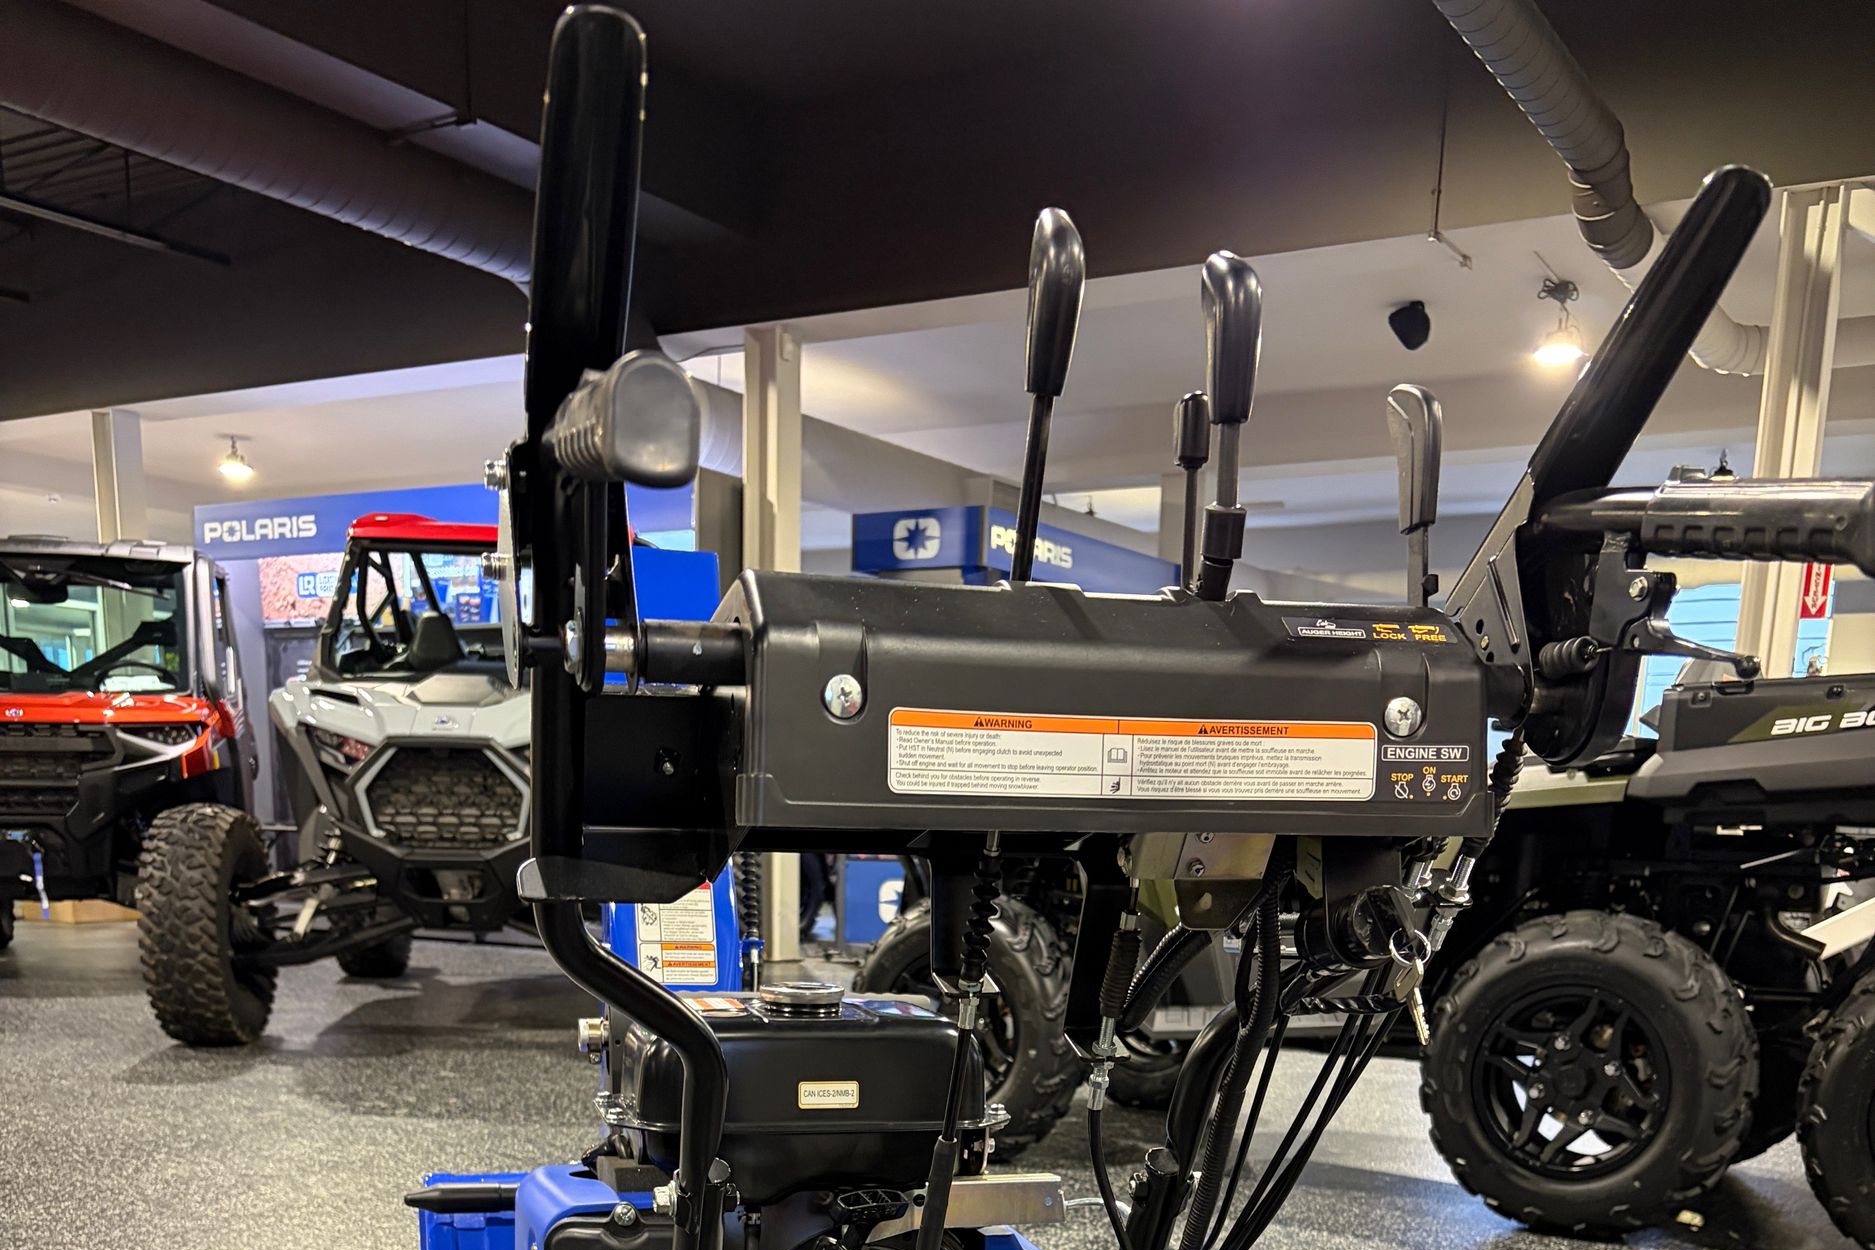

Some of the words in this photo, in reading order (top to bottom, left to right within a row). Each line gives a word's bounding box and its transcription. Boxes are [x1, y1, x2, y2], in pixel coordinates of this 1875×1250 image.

[204, 515, 316, 543] POLARIS
[991, 525, 1072, 568] POARIS
[984, 718, 1032, 728] WARNING
[1209, 726, 1289, 735] AVERTISSEMENT
[1770, 714, 1832, 735] BIG
[1387, 748, 1436, 758] ENGINE
[1440, 748, 1462, 758] SW
